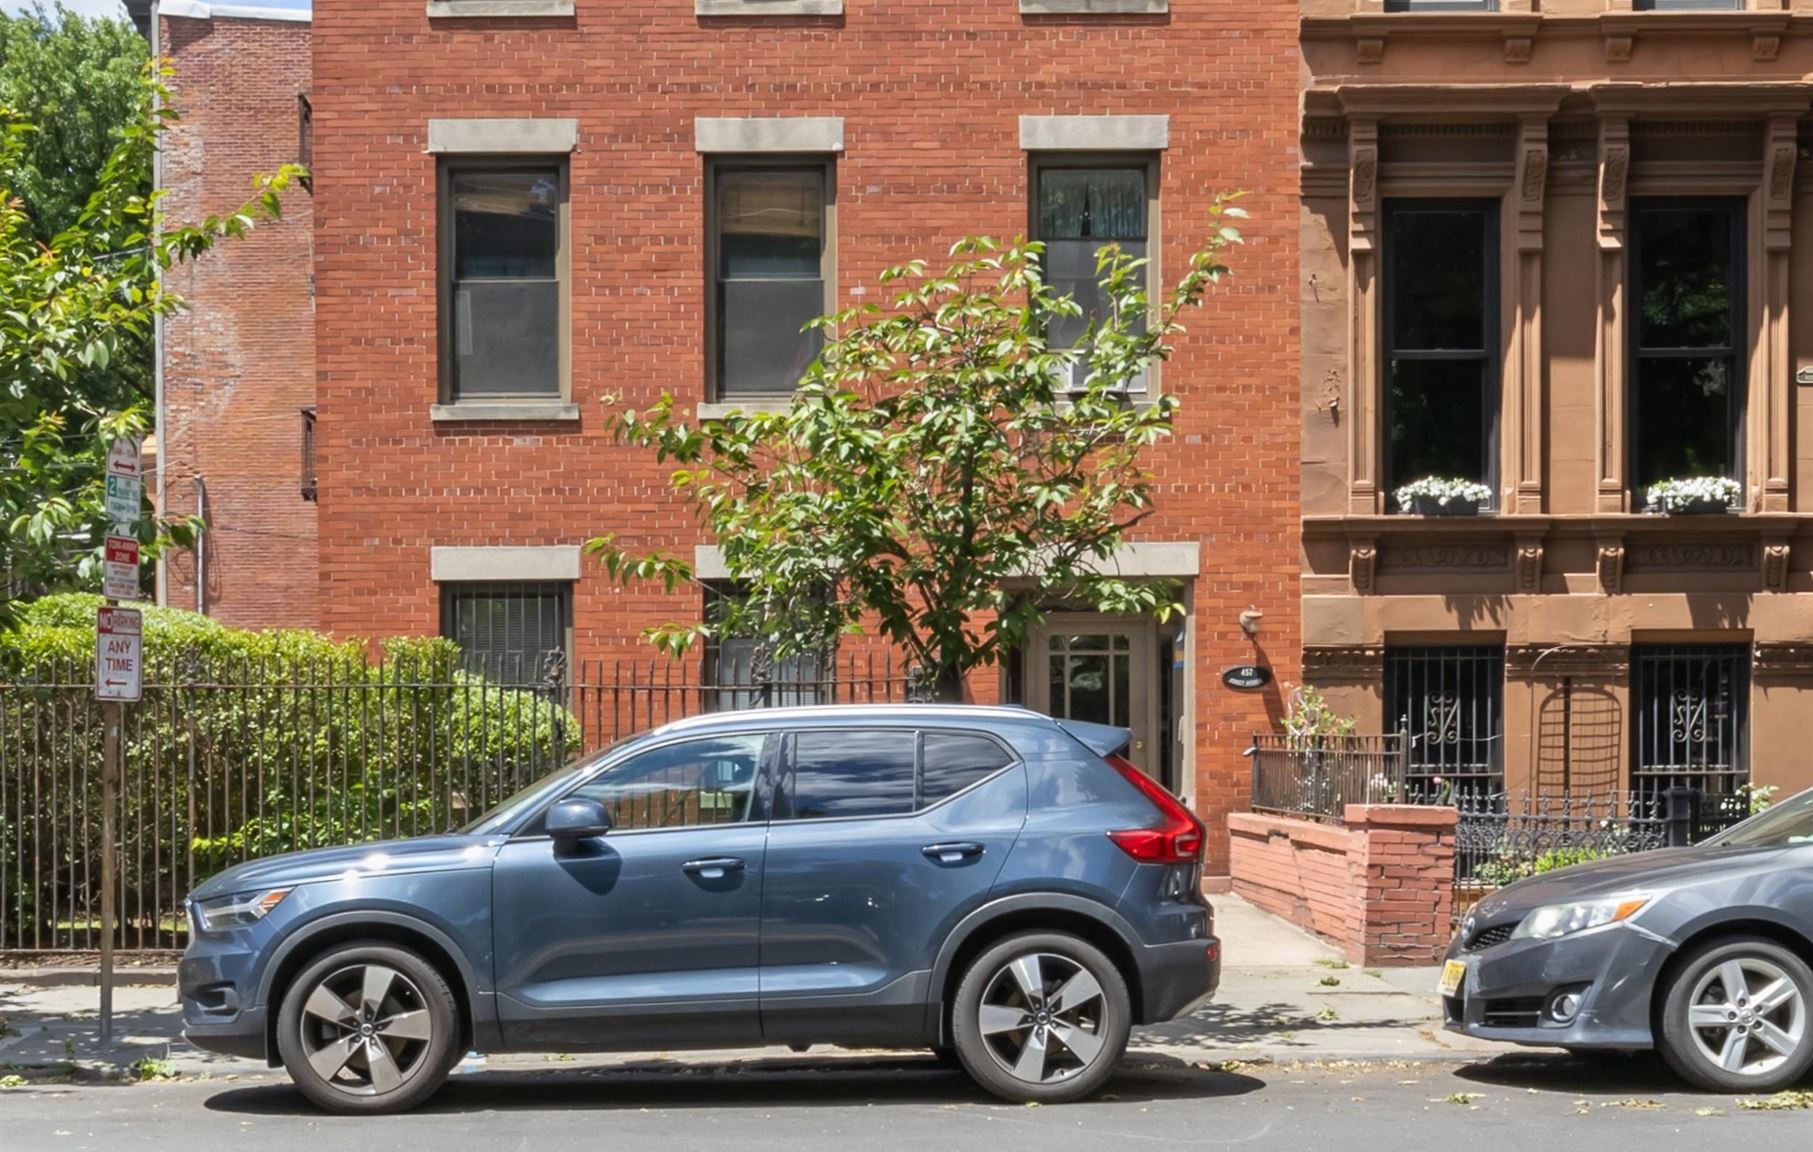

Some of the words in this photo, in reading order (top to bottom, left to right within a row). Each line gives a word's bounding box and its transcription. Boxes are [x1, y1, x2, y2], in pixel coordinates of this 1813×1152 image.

[109, 478, 116, 495] 2
[100, 612, 113, 629] NO
[108, 640, 131, 653] ANY
[106, 657, 132, 671] TIME
[1241, 668, 1253, 676] 457
